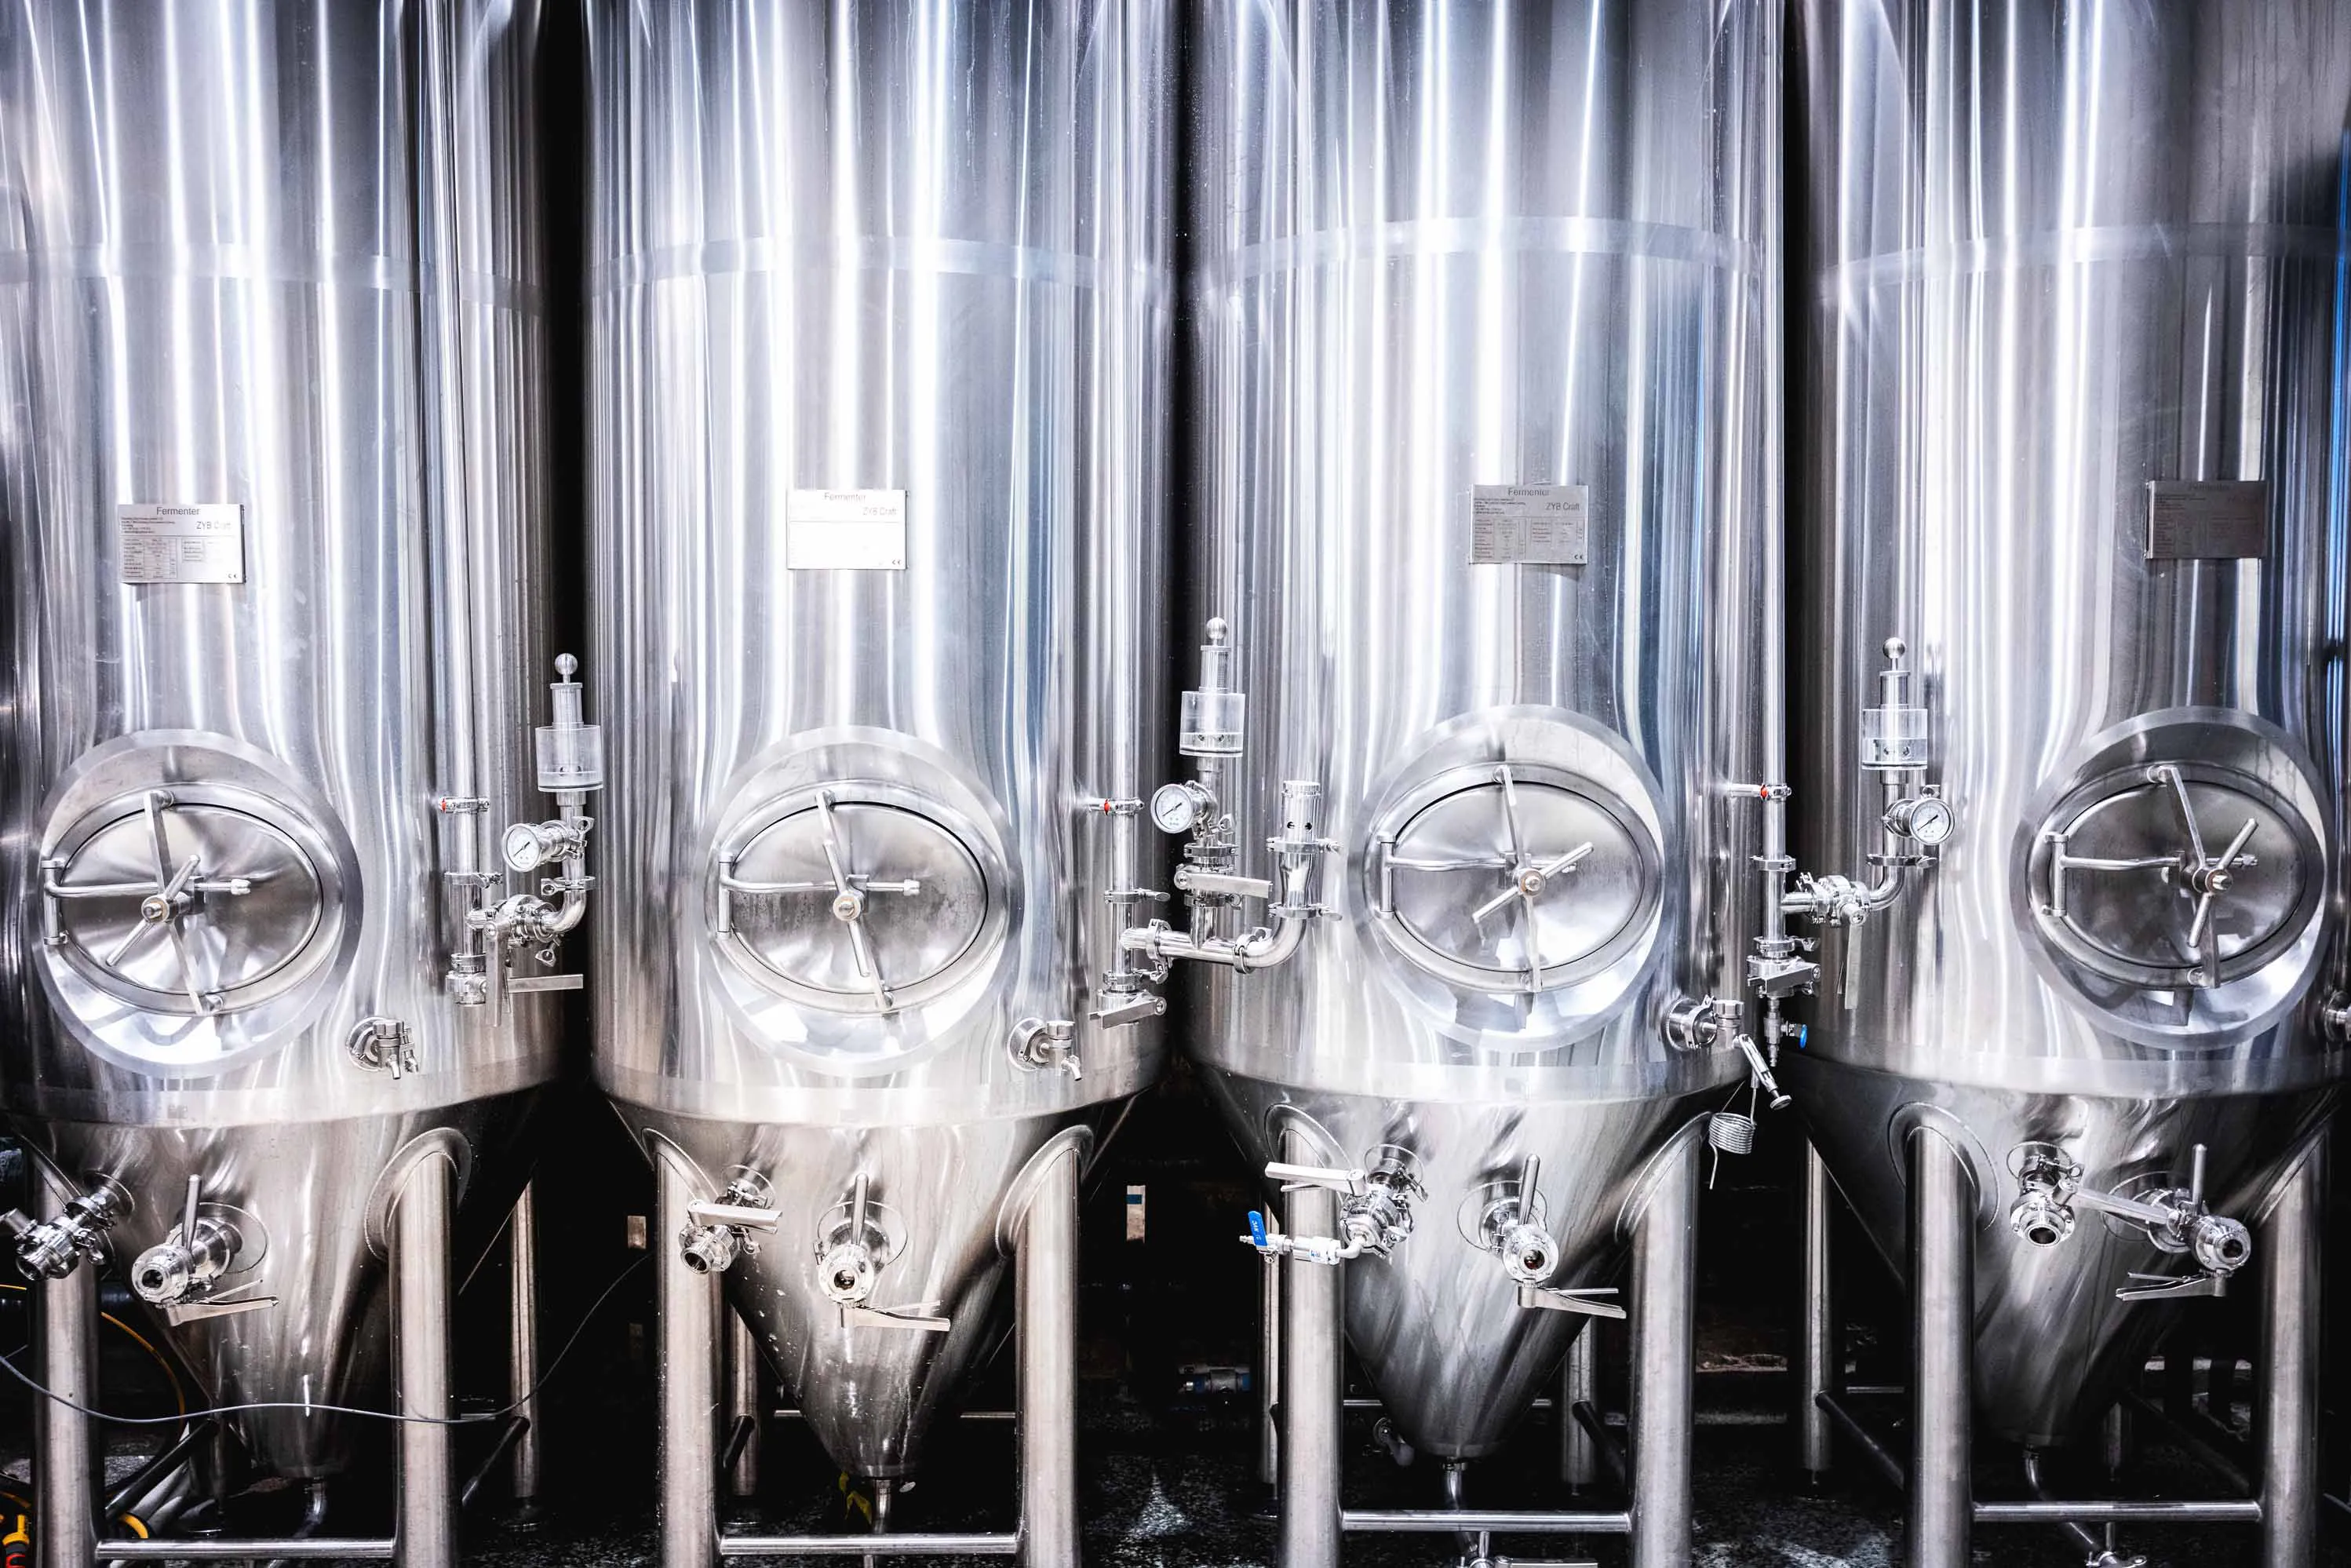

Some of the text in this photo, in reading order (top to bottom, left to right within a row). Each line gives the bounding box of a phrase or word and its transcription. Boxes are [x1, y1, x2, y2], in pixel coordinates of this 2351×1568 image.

[1507, 488, 1550, 497] Fermenter
[156, 506, 201, 516] Fermenter
[1545, 502, 1580, 512] ZYB Craft
[196, 521, 212, 530] ZYB
